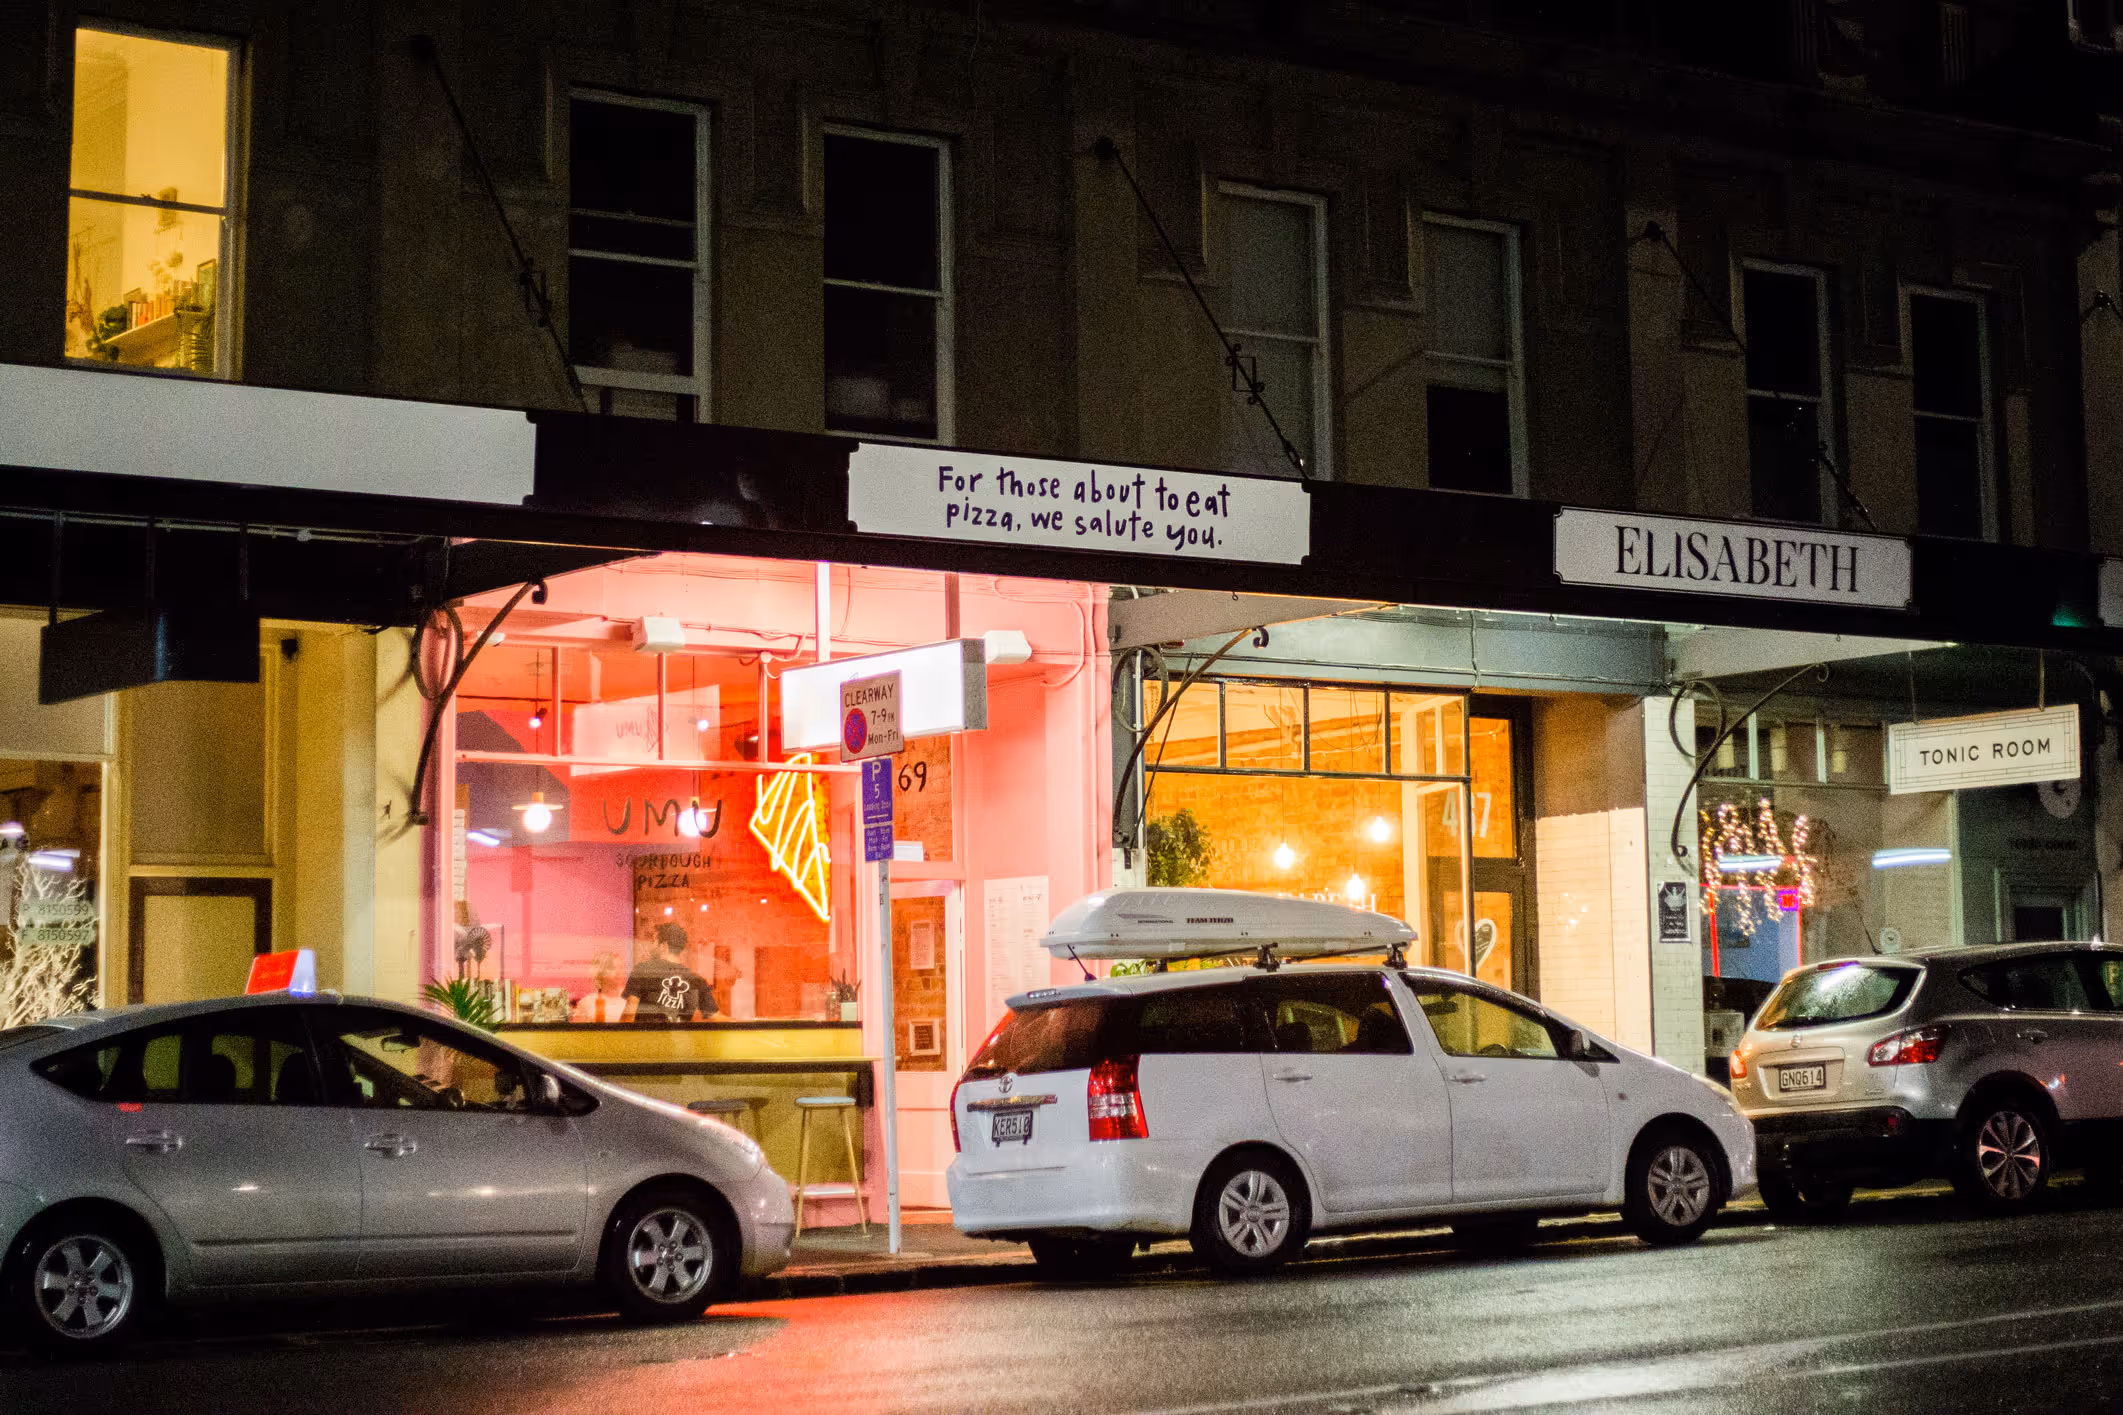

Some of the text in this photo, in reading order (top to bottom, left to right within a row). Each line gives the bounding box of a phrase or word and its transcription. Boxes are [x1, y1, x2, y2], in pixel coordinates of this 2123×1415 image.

[938, 465, 1231, 518] For those about to eat
[946, 497, 1223, 551] pizza, we salute you.
[1614, 525, 1861, 593] ELISABETH
[844, 683, 894, 708] CLEARWAY
[868, 728, 899, 746] Mon-Fri
[1919, 738, 2051, 766] TONIC ROOM
[871, 761, 882, 781] P
[898, 761, 928, 793] 69
[874, 783, 881, 799] 5
[603, 797, 722, 839] UMU
[637, 872, 690, 890] PIZZA
